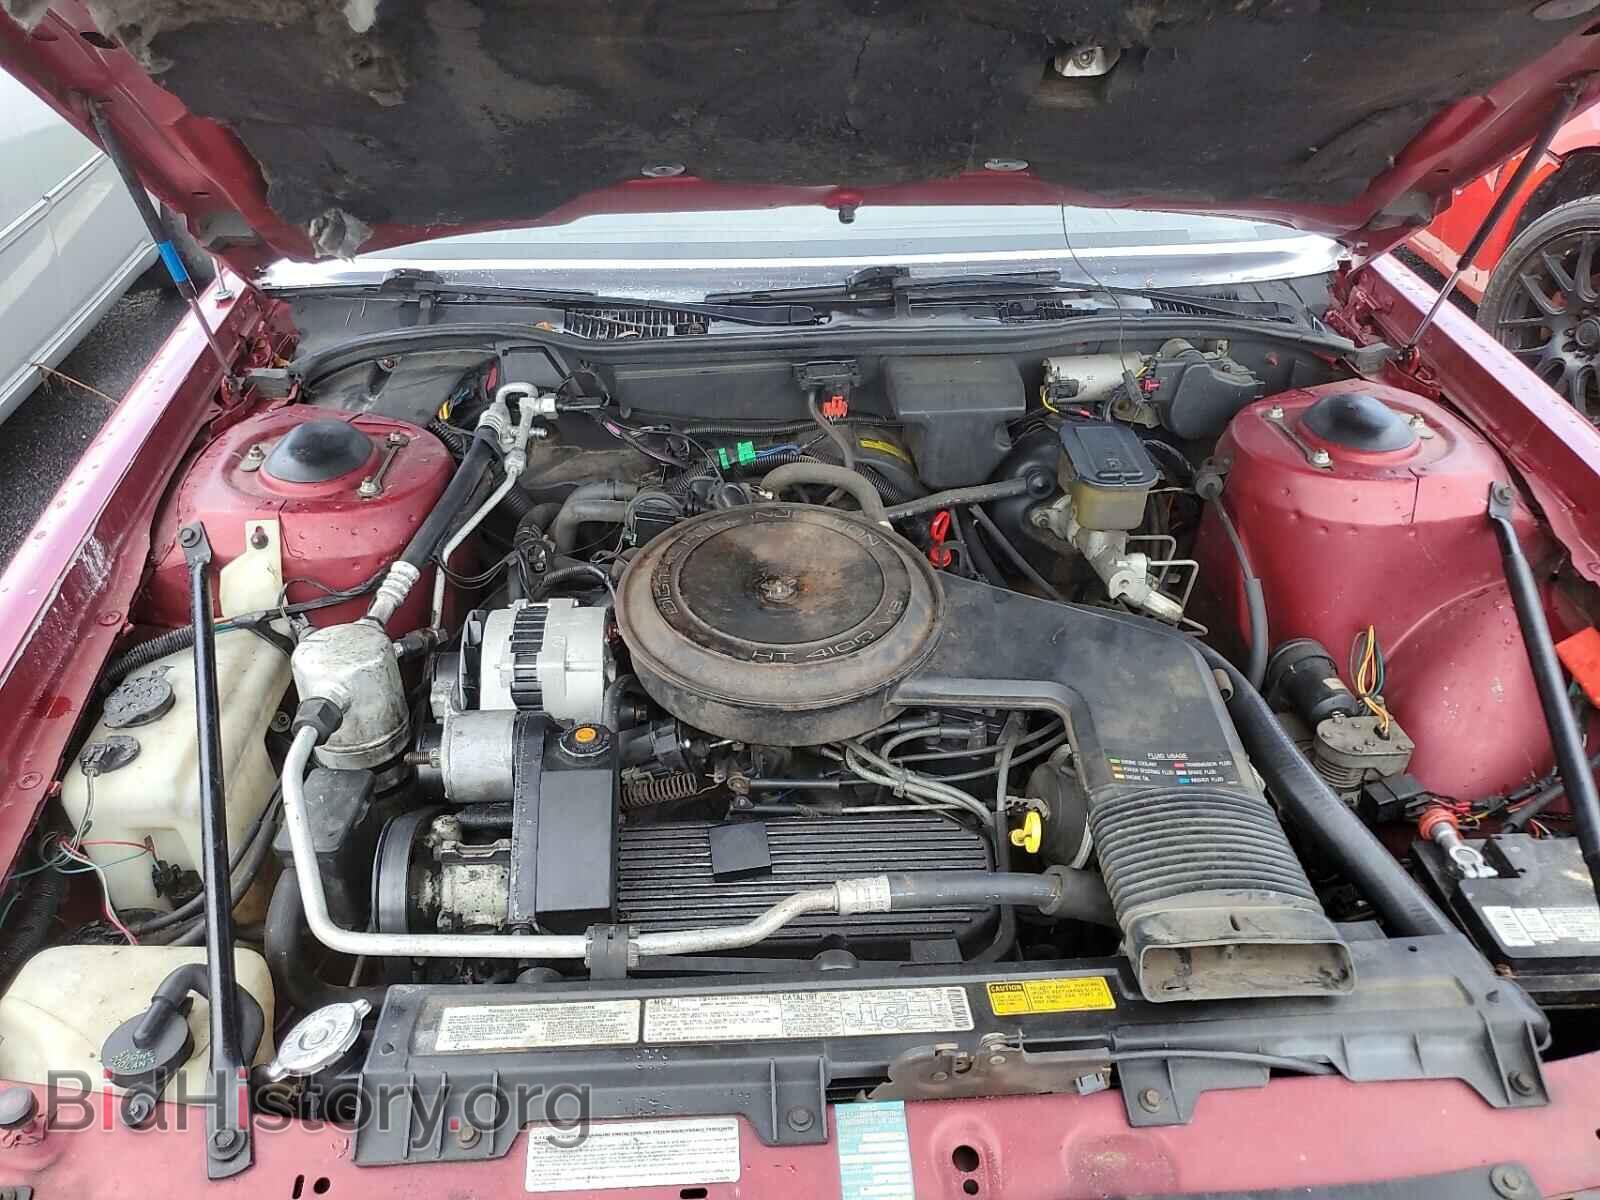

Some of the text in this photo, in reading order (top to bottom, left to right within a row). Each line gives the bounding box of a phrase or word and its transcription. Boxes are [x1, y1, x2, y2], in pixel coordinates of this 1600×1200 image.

[751, 599, 904, 662] HT 4100 V8
[990, 984, 1022, 993] CAUTION
